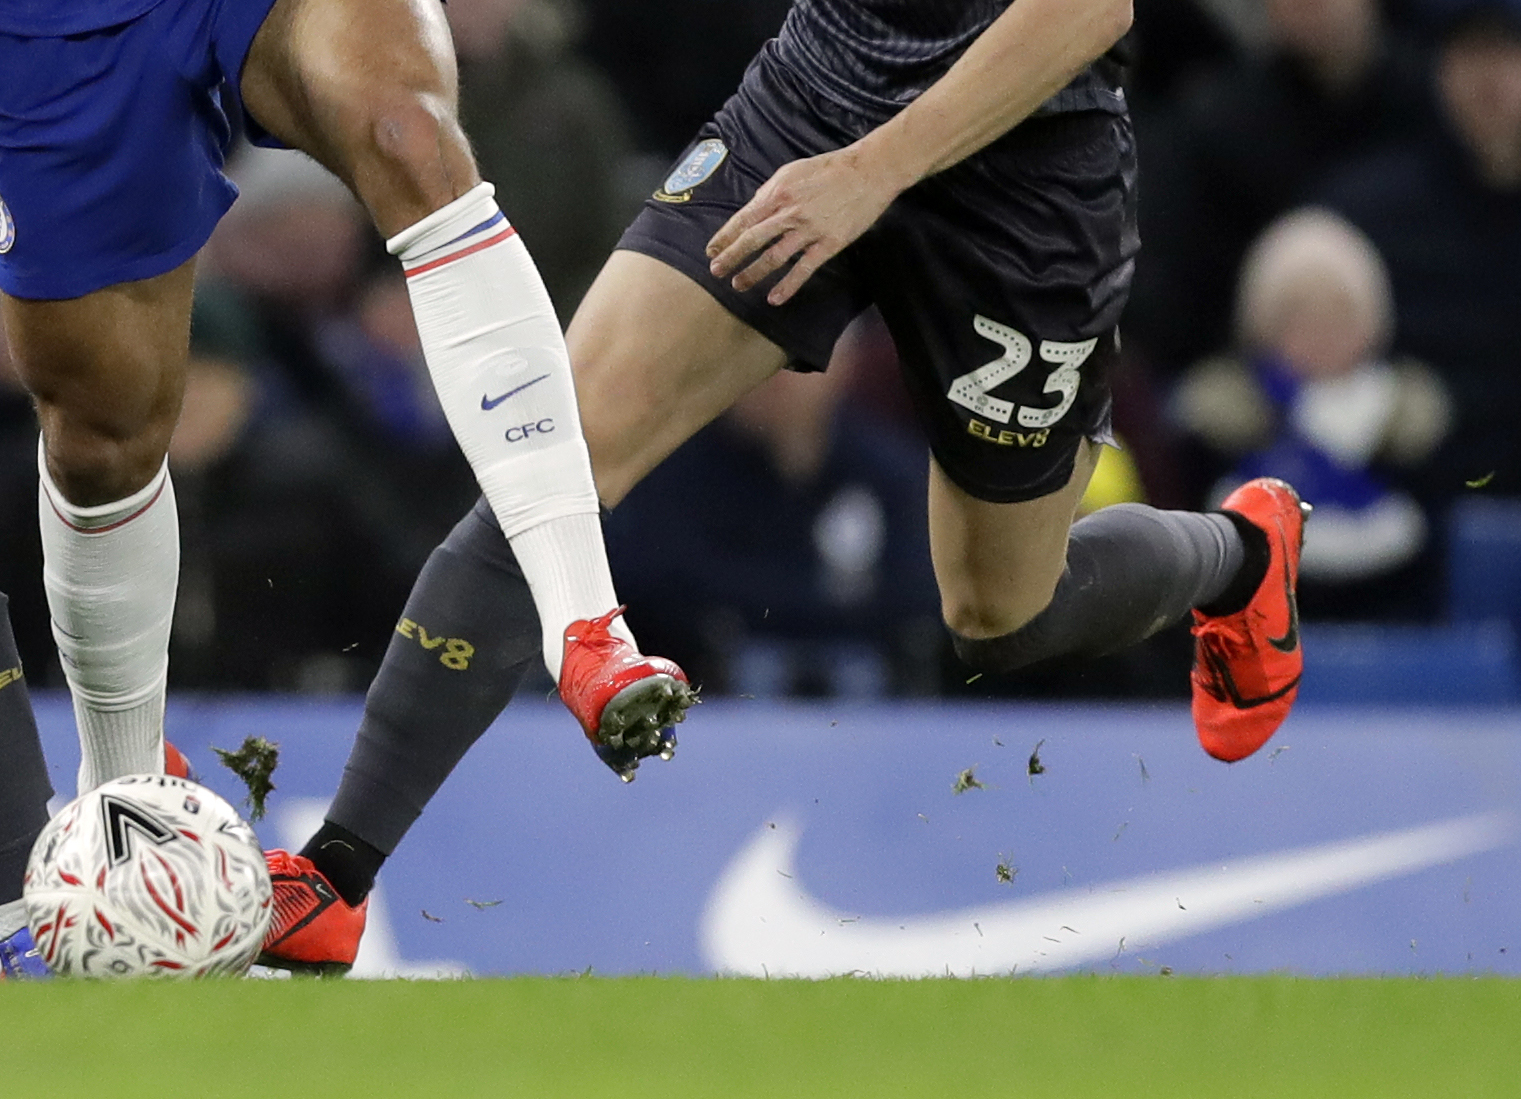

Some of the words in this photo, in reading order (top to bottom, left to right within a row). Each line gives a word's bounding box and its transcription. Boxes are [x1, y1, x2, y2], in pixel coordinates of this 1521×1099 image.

[946, 312, 1099, 429] 23
[504, 417, 556, 443] CFC
[967, 418, 1051, 448] ELEV8
